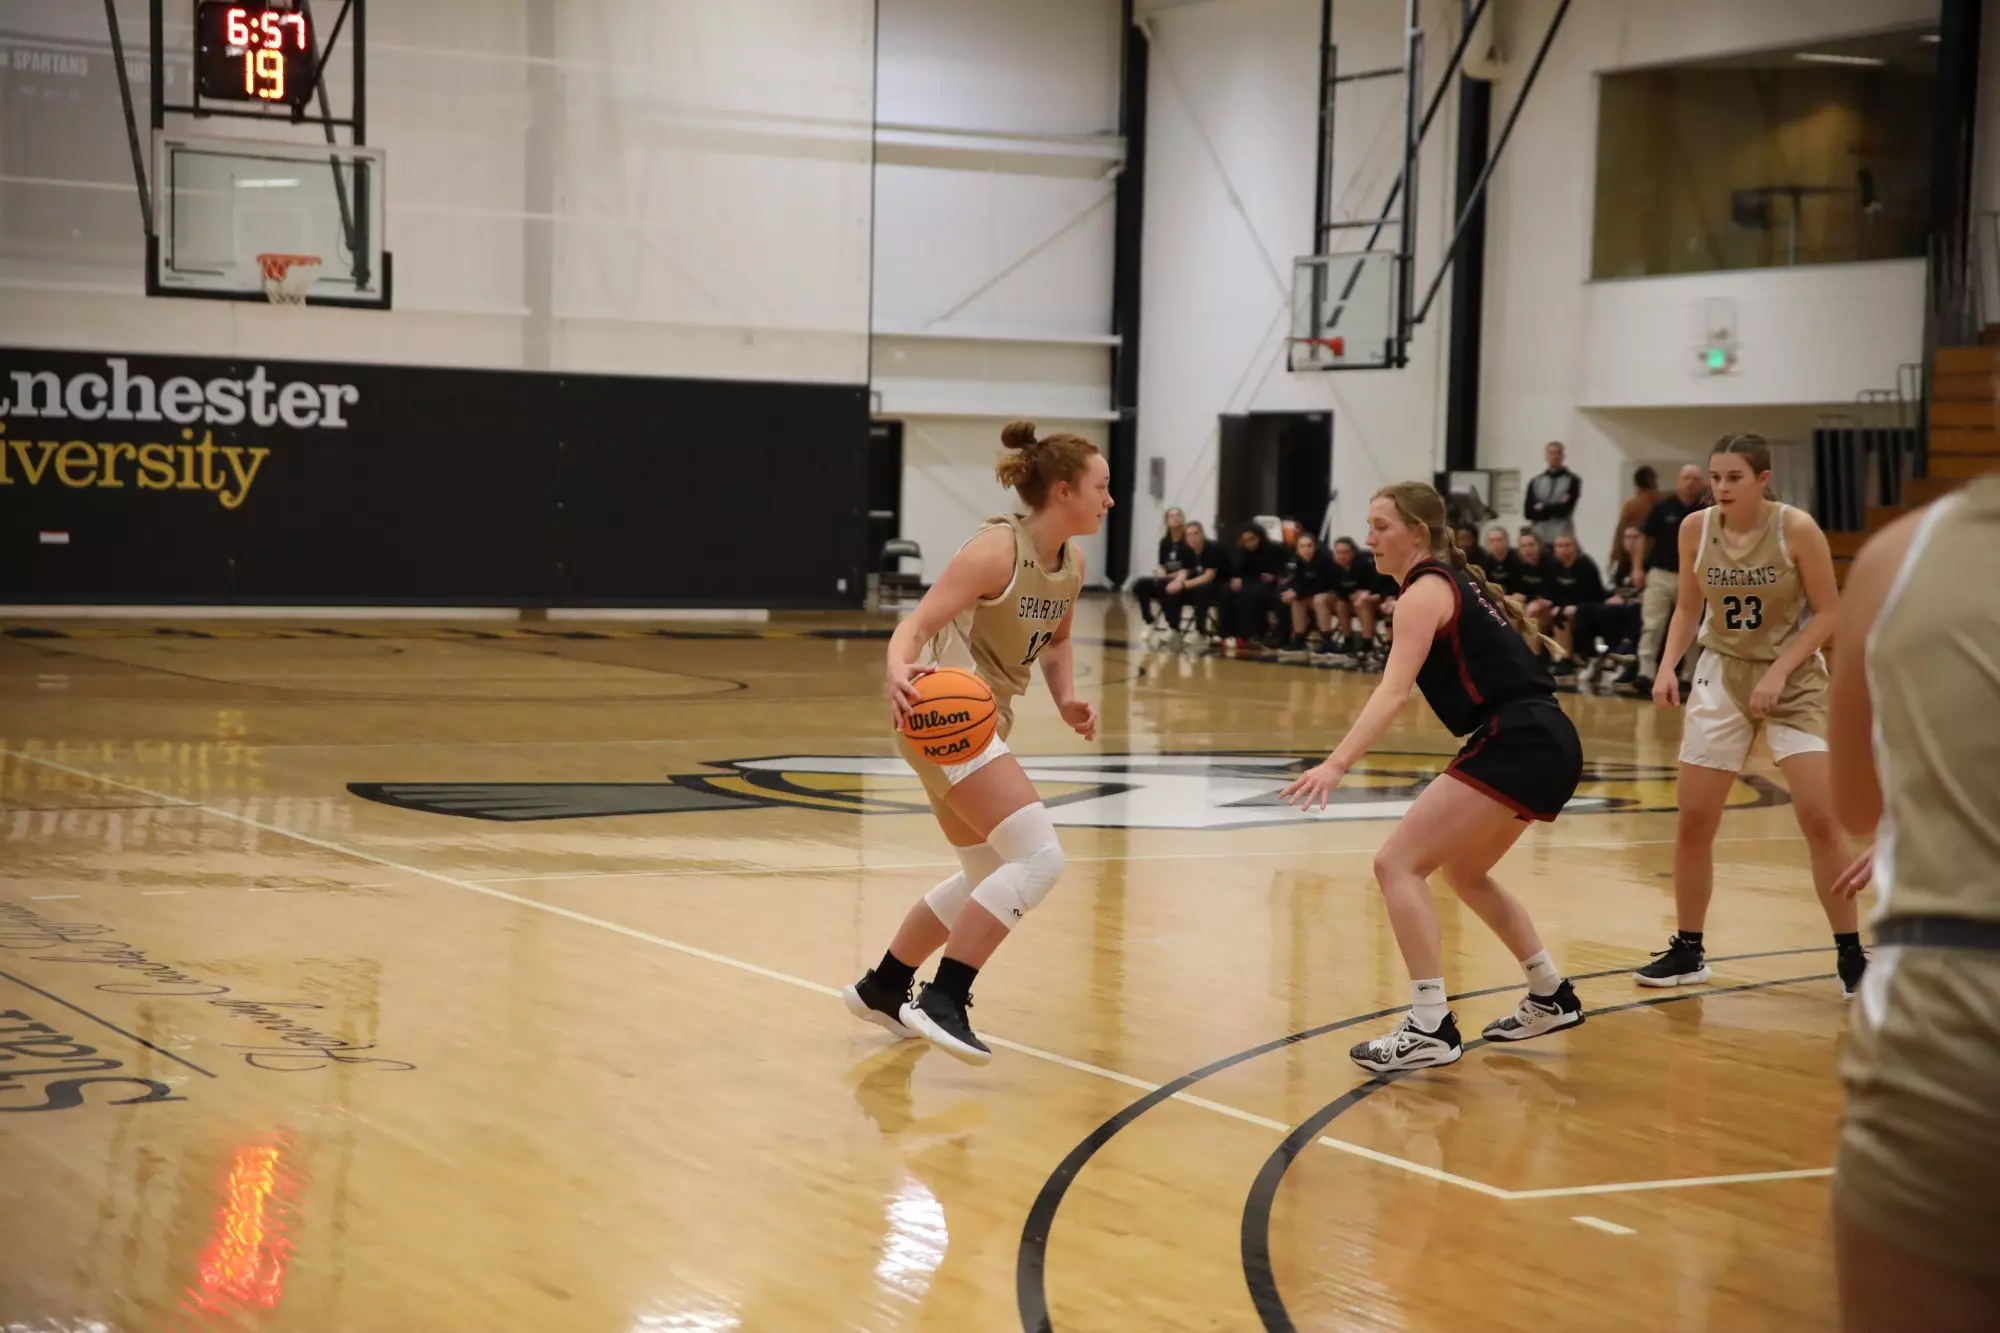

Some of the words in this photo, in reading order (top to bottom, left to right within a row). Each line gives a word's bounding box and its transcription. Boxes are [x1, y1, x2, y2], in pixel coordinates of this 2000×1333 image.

[227, 8, 306, 50] 6:57
[12, 49, 89, 77] SPARTANS
[245, 48, 285, 99] 19
[0, 358, 360, 428] nchester
[1707, 566, 1777, 586] SPARTANS
[1722, 594, 1763, 630] 23
[908, 710, 971, 731] Wilson
[923, 737, 971, 757] NCAA
